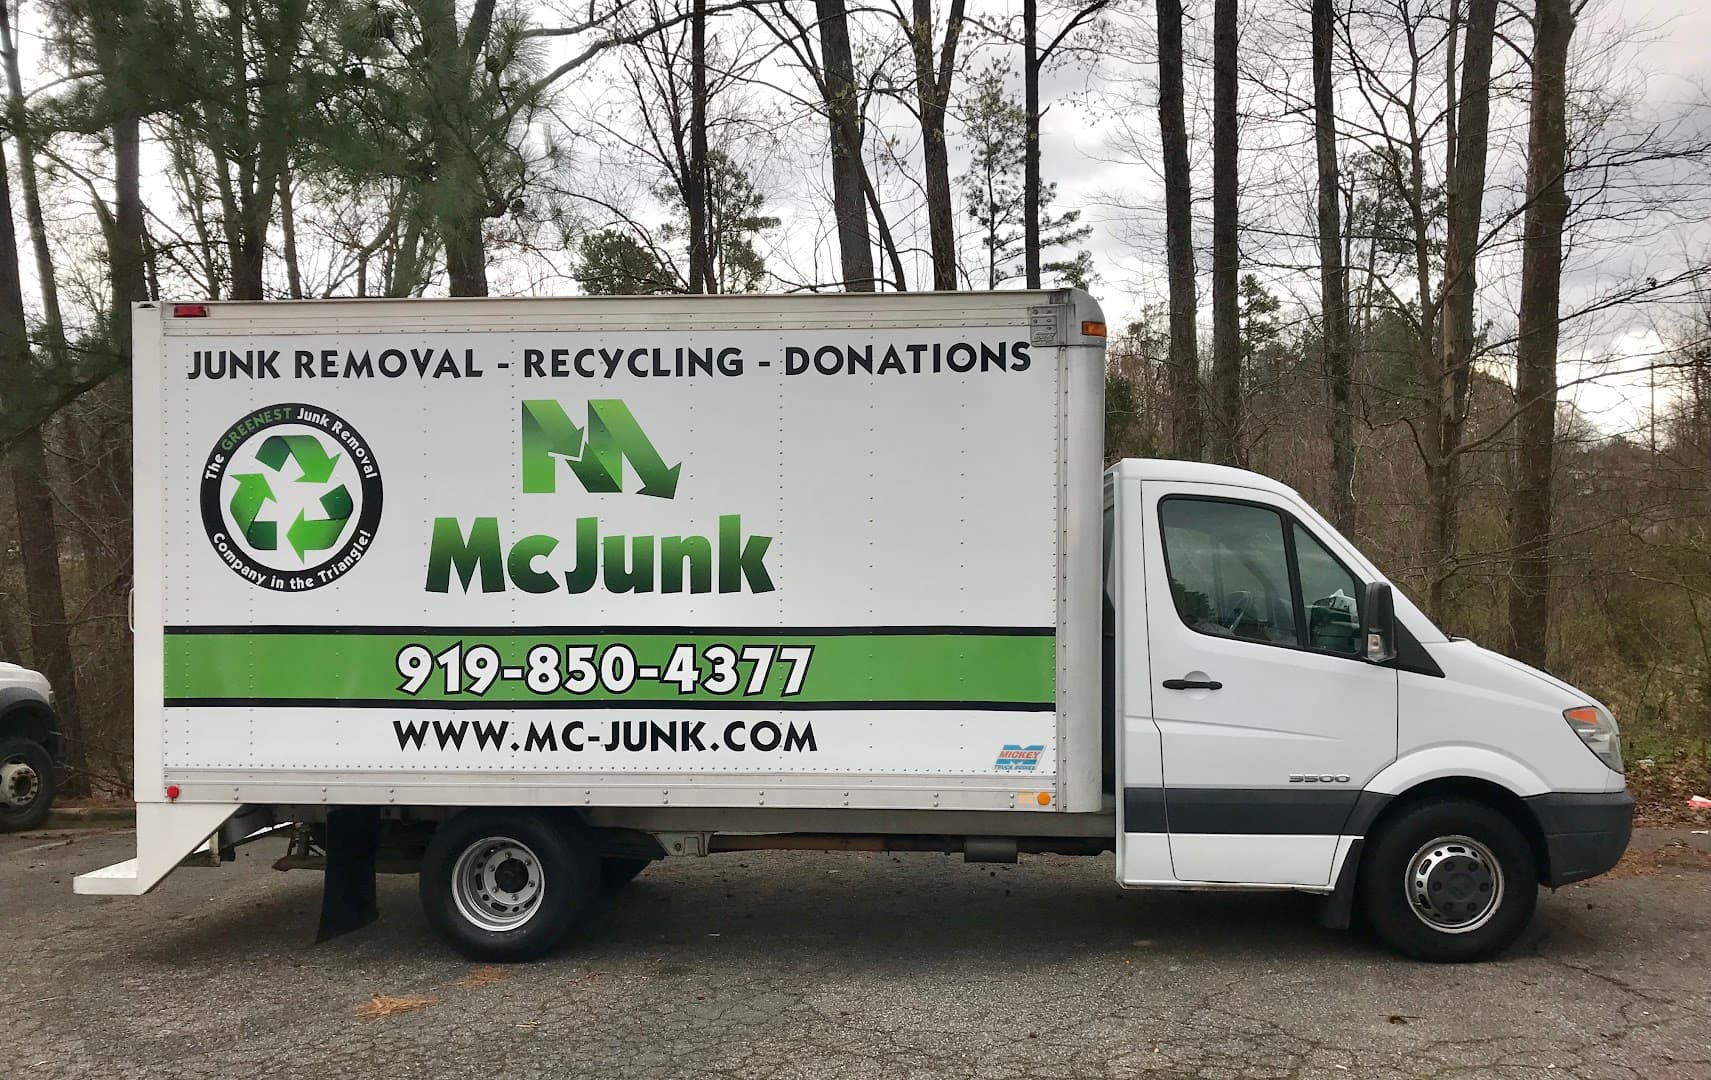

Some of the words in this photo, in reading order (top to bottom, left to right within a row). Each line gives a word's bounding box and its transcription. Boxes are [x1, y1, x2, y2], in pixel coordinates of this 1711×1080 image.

[187, 350, 281, 380] JUNK
[294, 348, 484, 379] REMOVAL
[524, 347, 744, 378] RECYCLING
[785, 341, 1031, 376] DONATIONS
[205, 453, 225, 480] The
[221, 407, 292, 450] GREENEST
[297, 407, 330, 427] Junk
[331, 420, 378, 479] Removal
[213, 532, 267, 586] Company
[270, 575, 284, 589] in
[289, 577, 315, 589] the
[317, 529, 372, 583] Triangle!
[424, 514, 776, 595] McJunk
[395, 640, 817, 698] 919-850-4377
[392, 719, 818, 753] WWW.MC-JUNK.COM
[998, 750, 1041, 759] MICKEY
[1288, 773, 1351, 783] 3500
